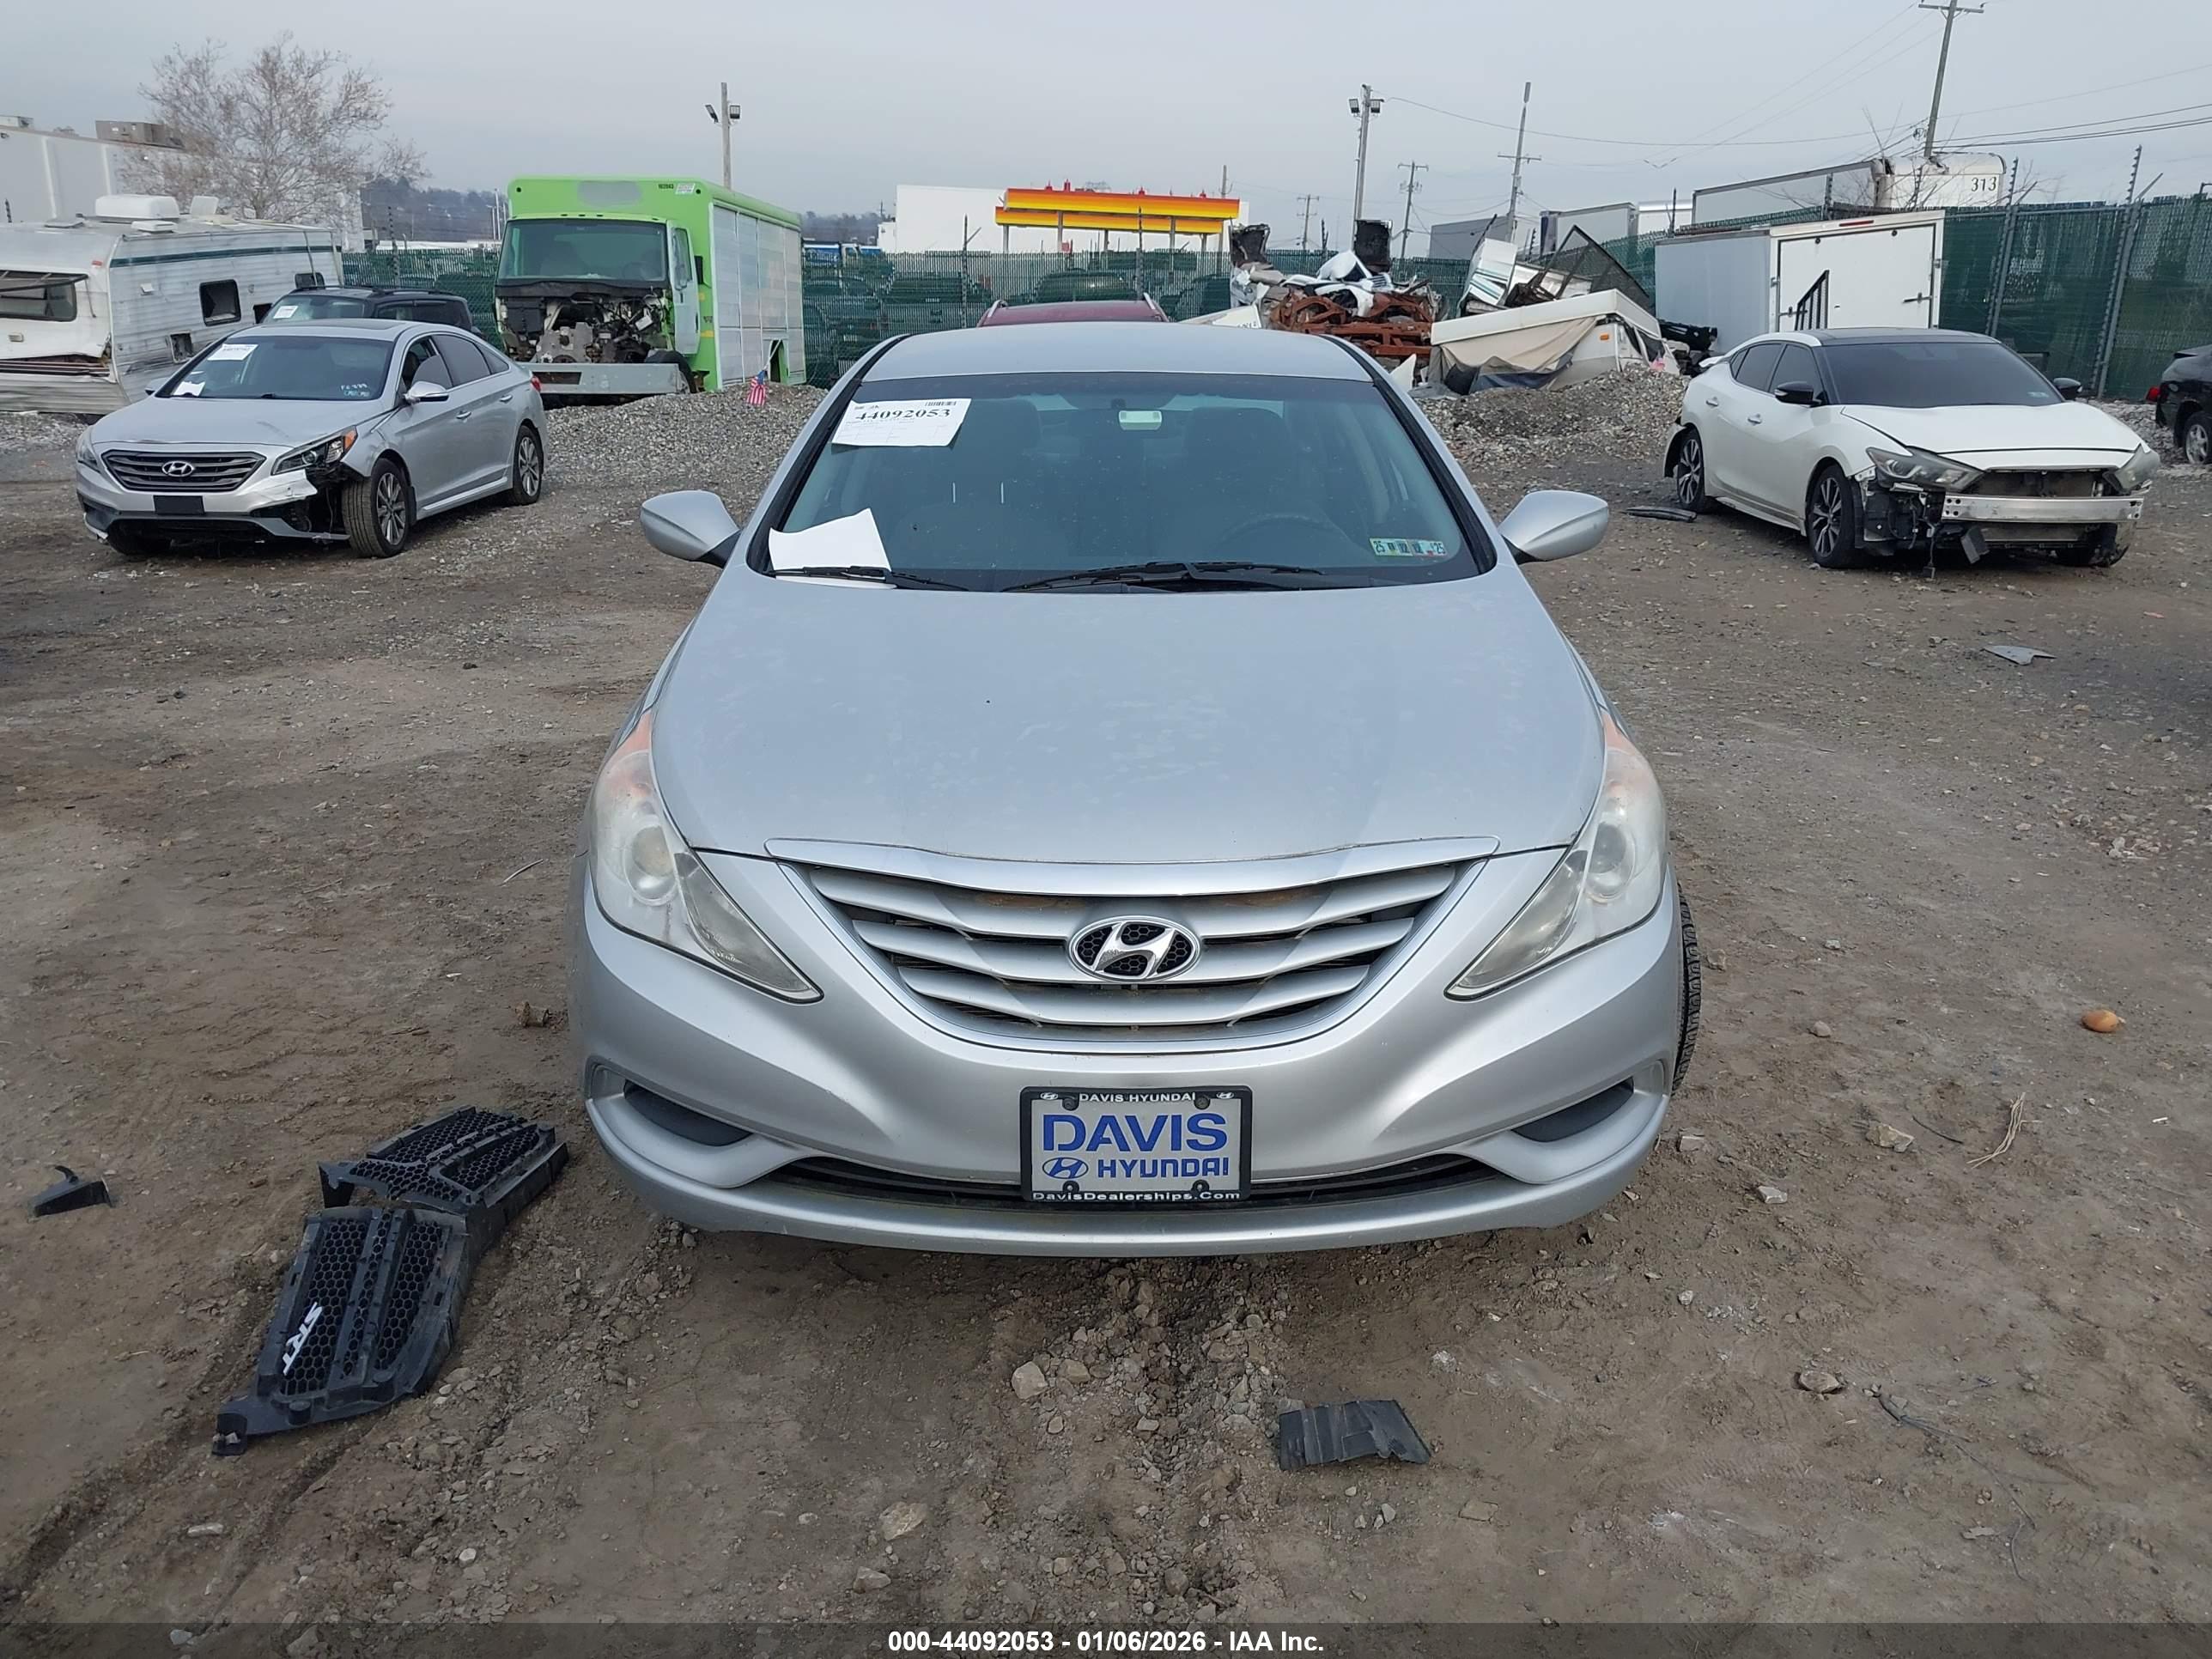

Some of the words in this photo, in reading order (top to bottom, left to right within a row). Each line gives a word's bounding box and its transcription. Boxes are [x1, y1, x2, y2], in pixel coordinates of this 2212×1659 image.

[1971, 176, 1996, 191] 313
[855, 409, 951, 420] 44092053
[1079, 1093, 1125, 1103] DAVIS
[1128, 1092, 1196, 1103] HYUNDAI
[1043, 1113, 1228, 1152] DAVIS
[1097, 1157, 1229, 1178] HYUNDAI
[1033, 1190, 1241, 1201] DavisDealerships.Com
